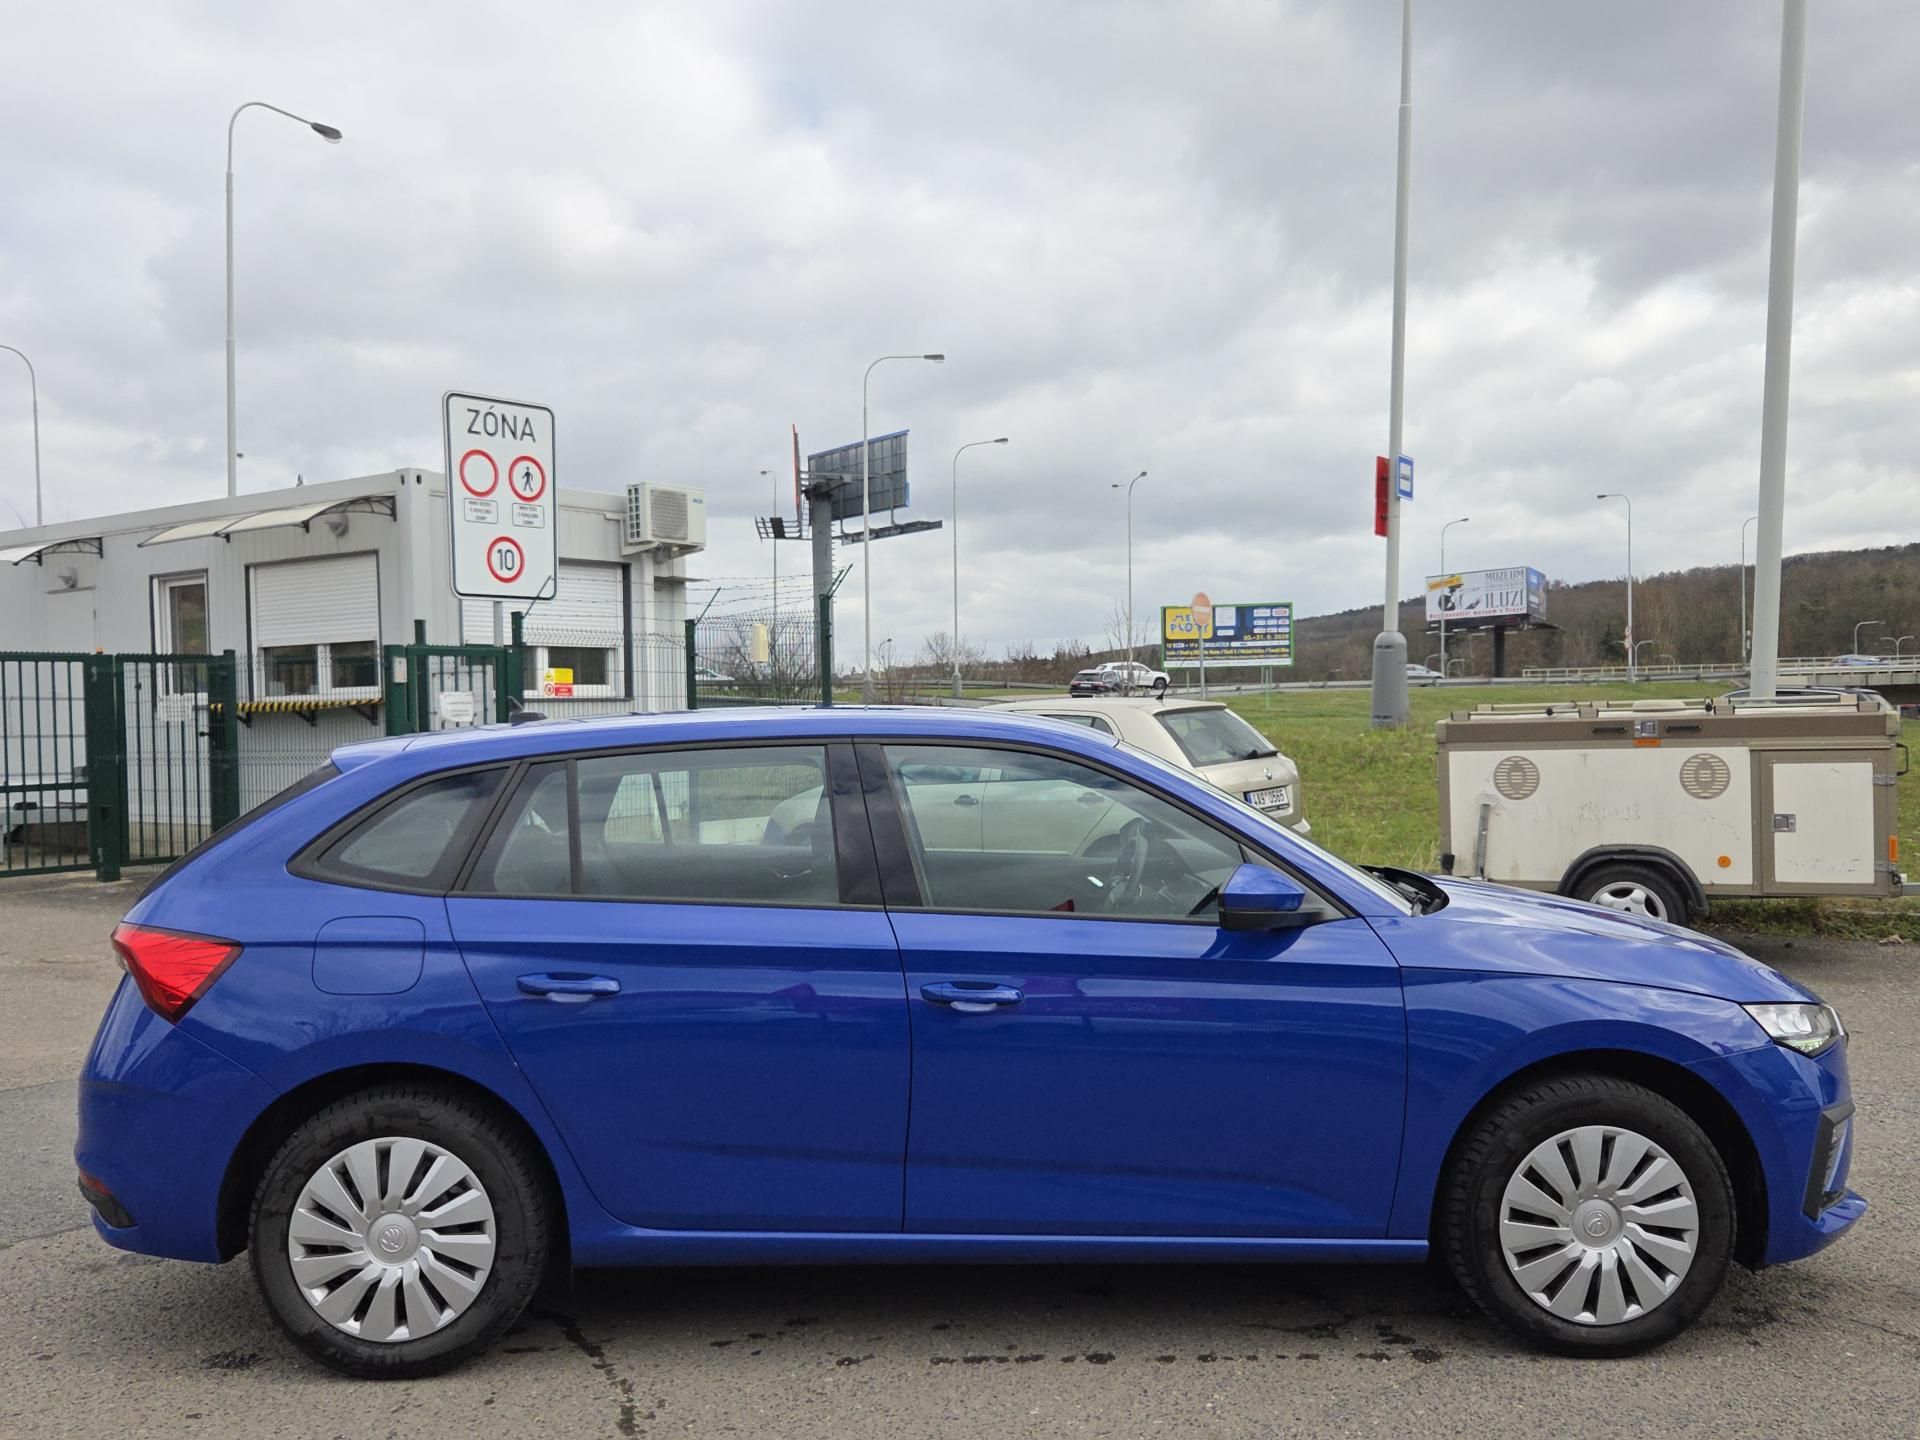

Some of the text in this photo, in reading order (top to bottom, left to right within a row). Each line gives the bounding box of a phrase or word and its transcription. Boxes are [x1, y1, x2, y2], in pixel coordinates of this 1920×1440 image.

[467, 405, 536, 443] ZÓNA
[497, 548, 515, 572] 10
[1485, 569, 1524, 581] MUZEUM
